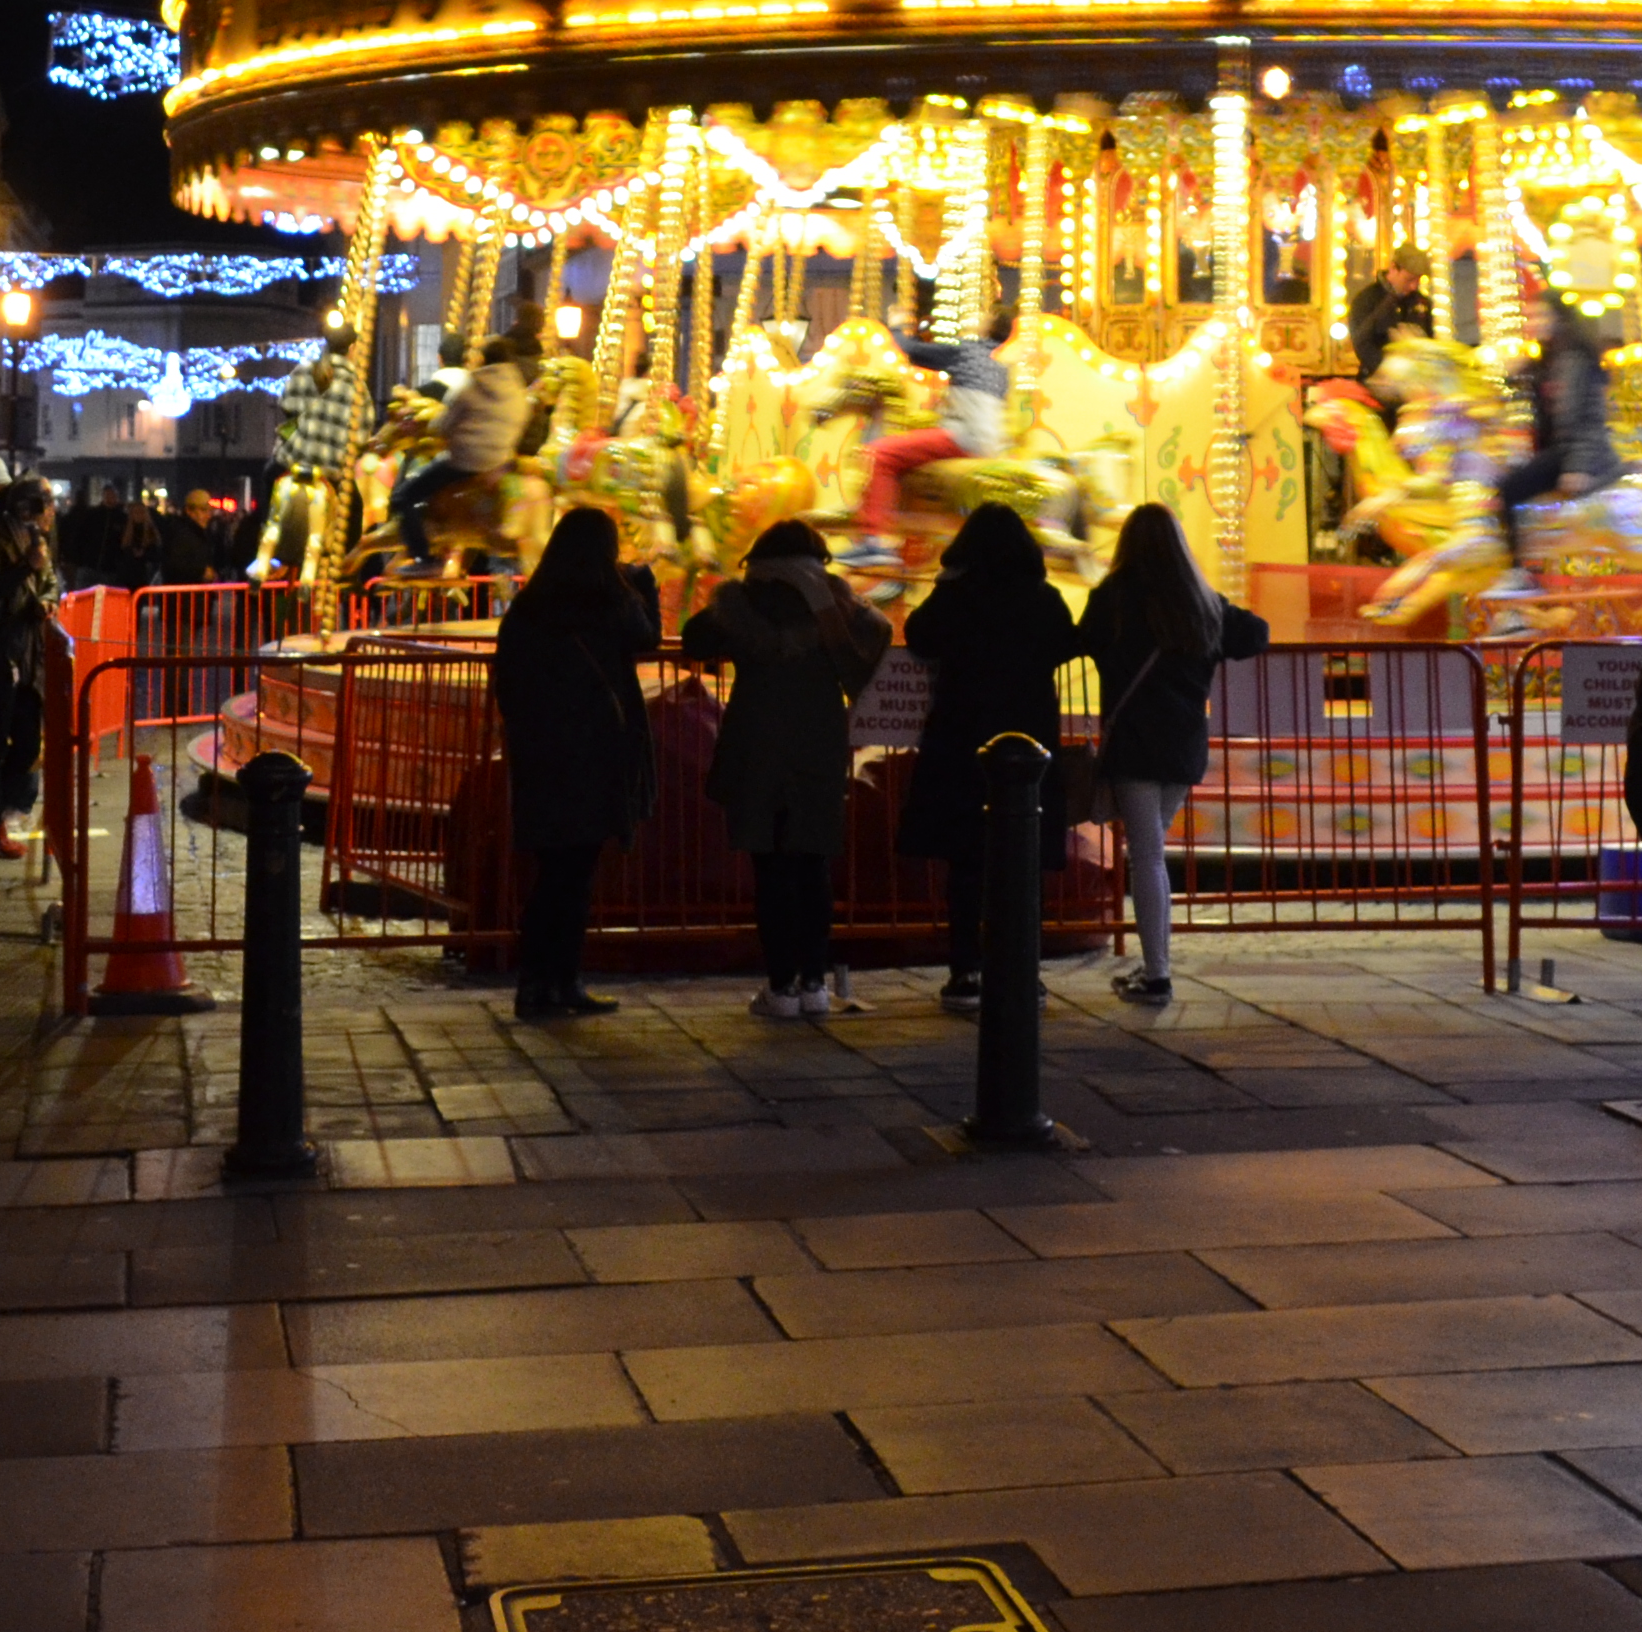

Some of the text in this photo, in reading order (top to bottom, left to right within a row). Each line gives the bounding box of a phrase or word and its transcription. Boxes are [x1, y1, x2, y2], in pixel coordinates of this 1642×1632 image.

[1597, 660, 1642, 672] YOUN
[875, 679, 933, 694] CHILD
[879, 699, 929, 712] MUST
[1587, 697, 1633, 709] MUST
